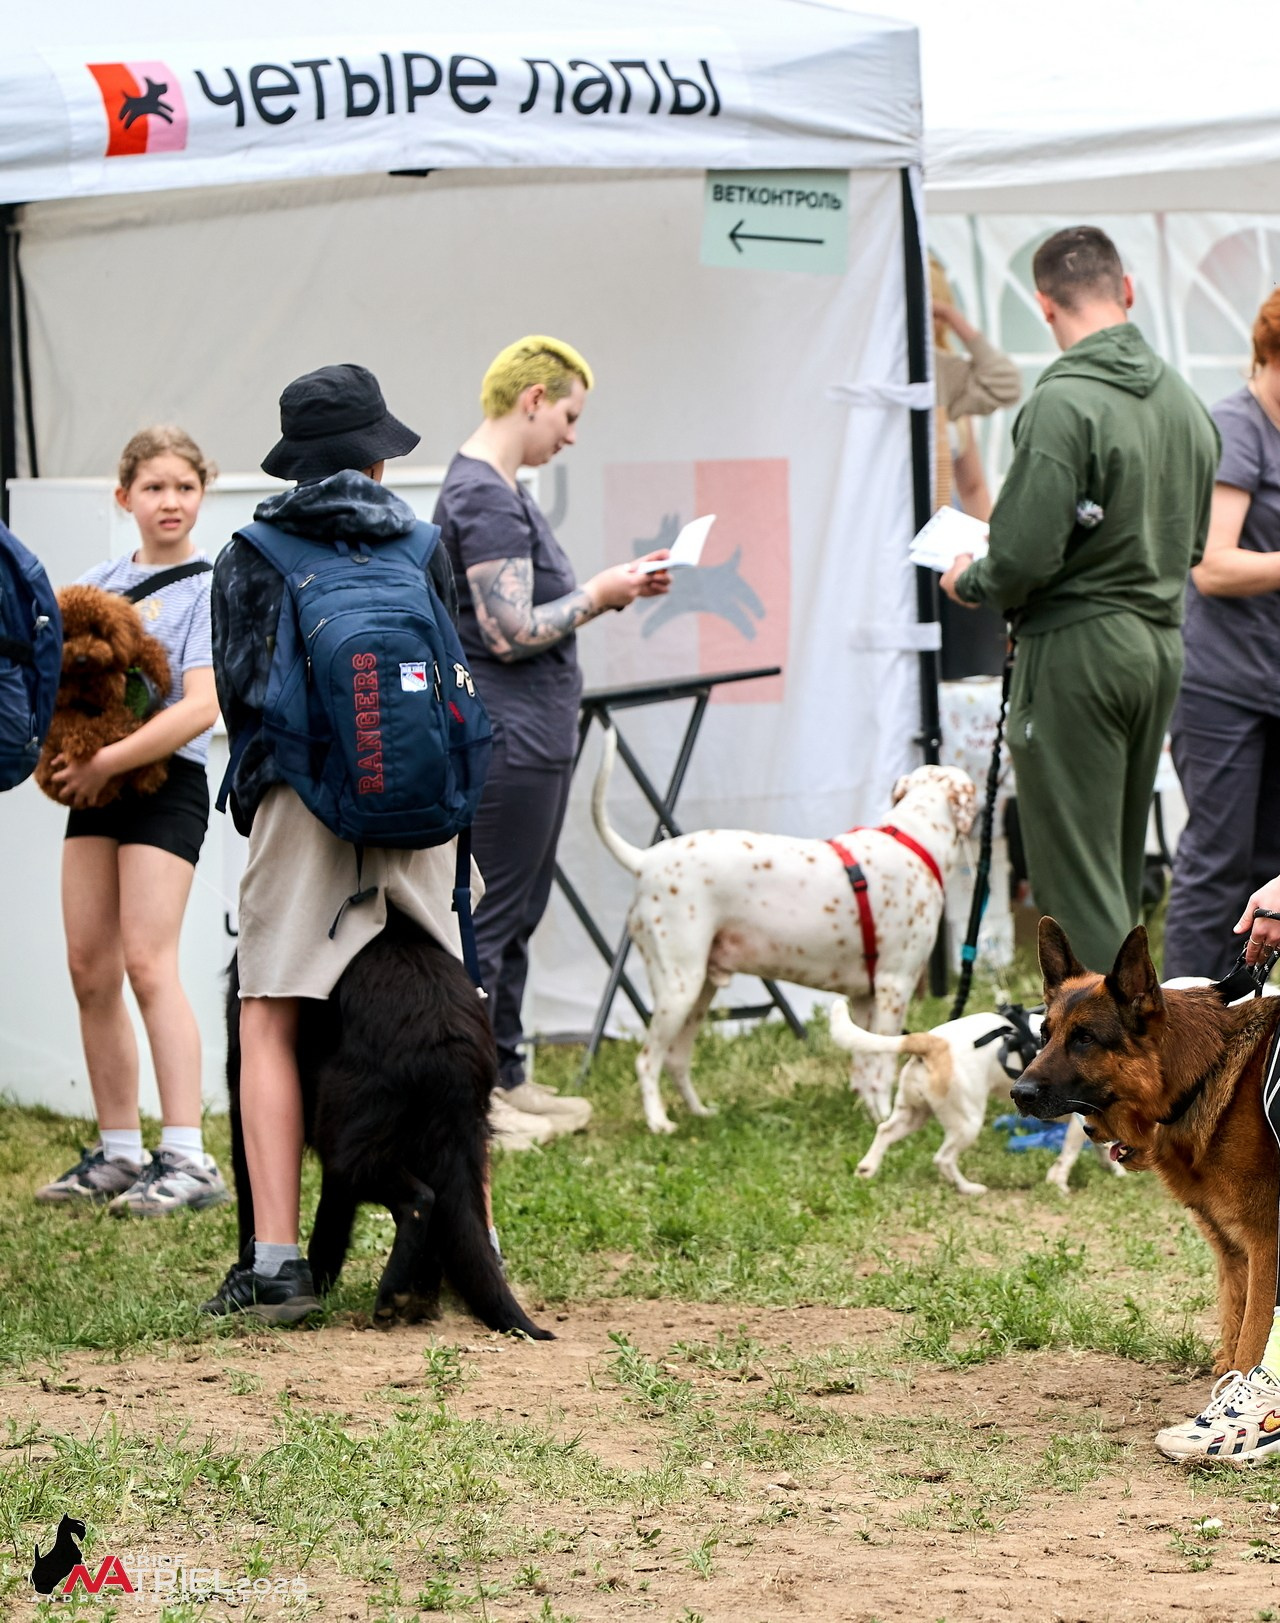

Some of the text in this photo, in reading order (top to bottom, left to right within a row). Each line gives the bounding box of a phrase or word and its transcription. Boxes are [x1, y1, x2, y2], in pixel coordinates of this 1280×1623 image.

[194, 52, 721, 127] четыре лапы
[712, 184, 843, 210] ВЕТКОНТРОЛЬ
[352, 653, 384, 795] RANGERS
